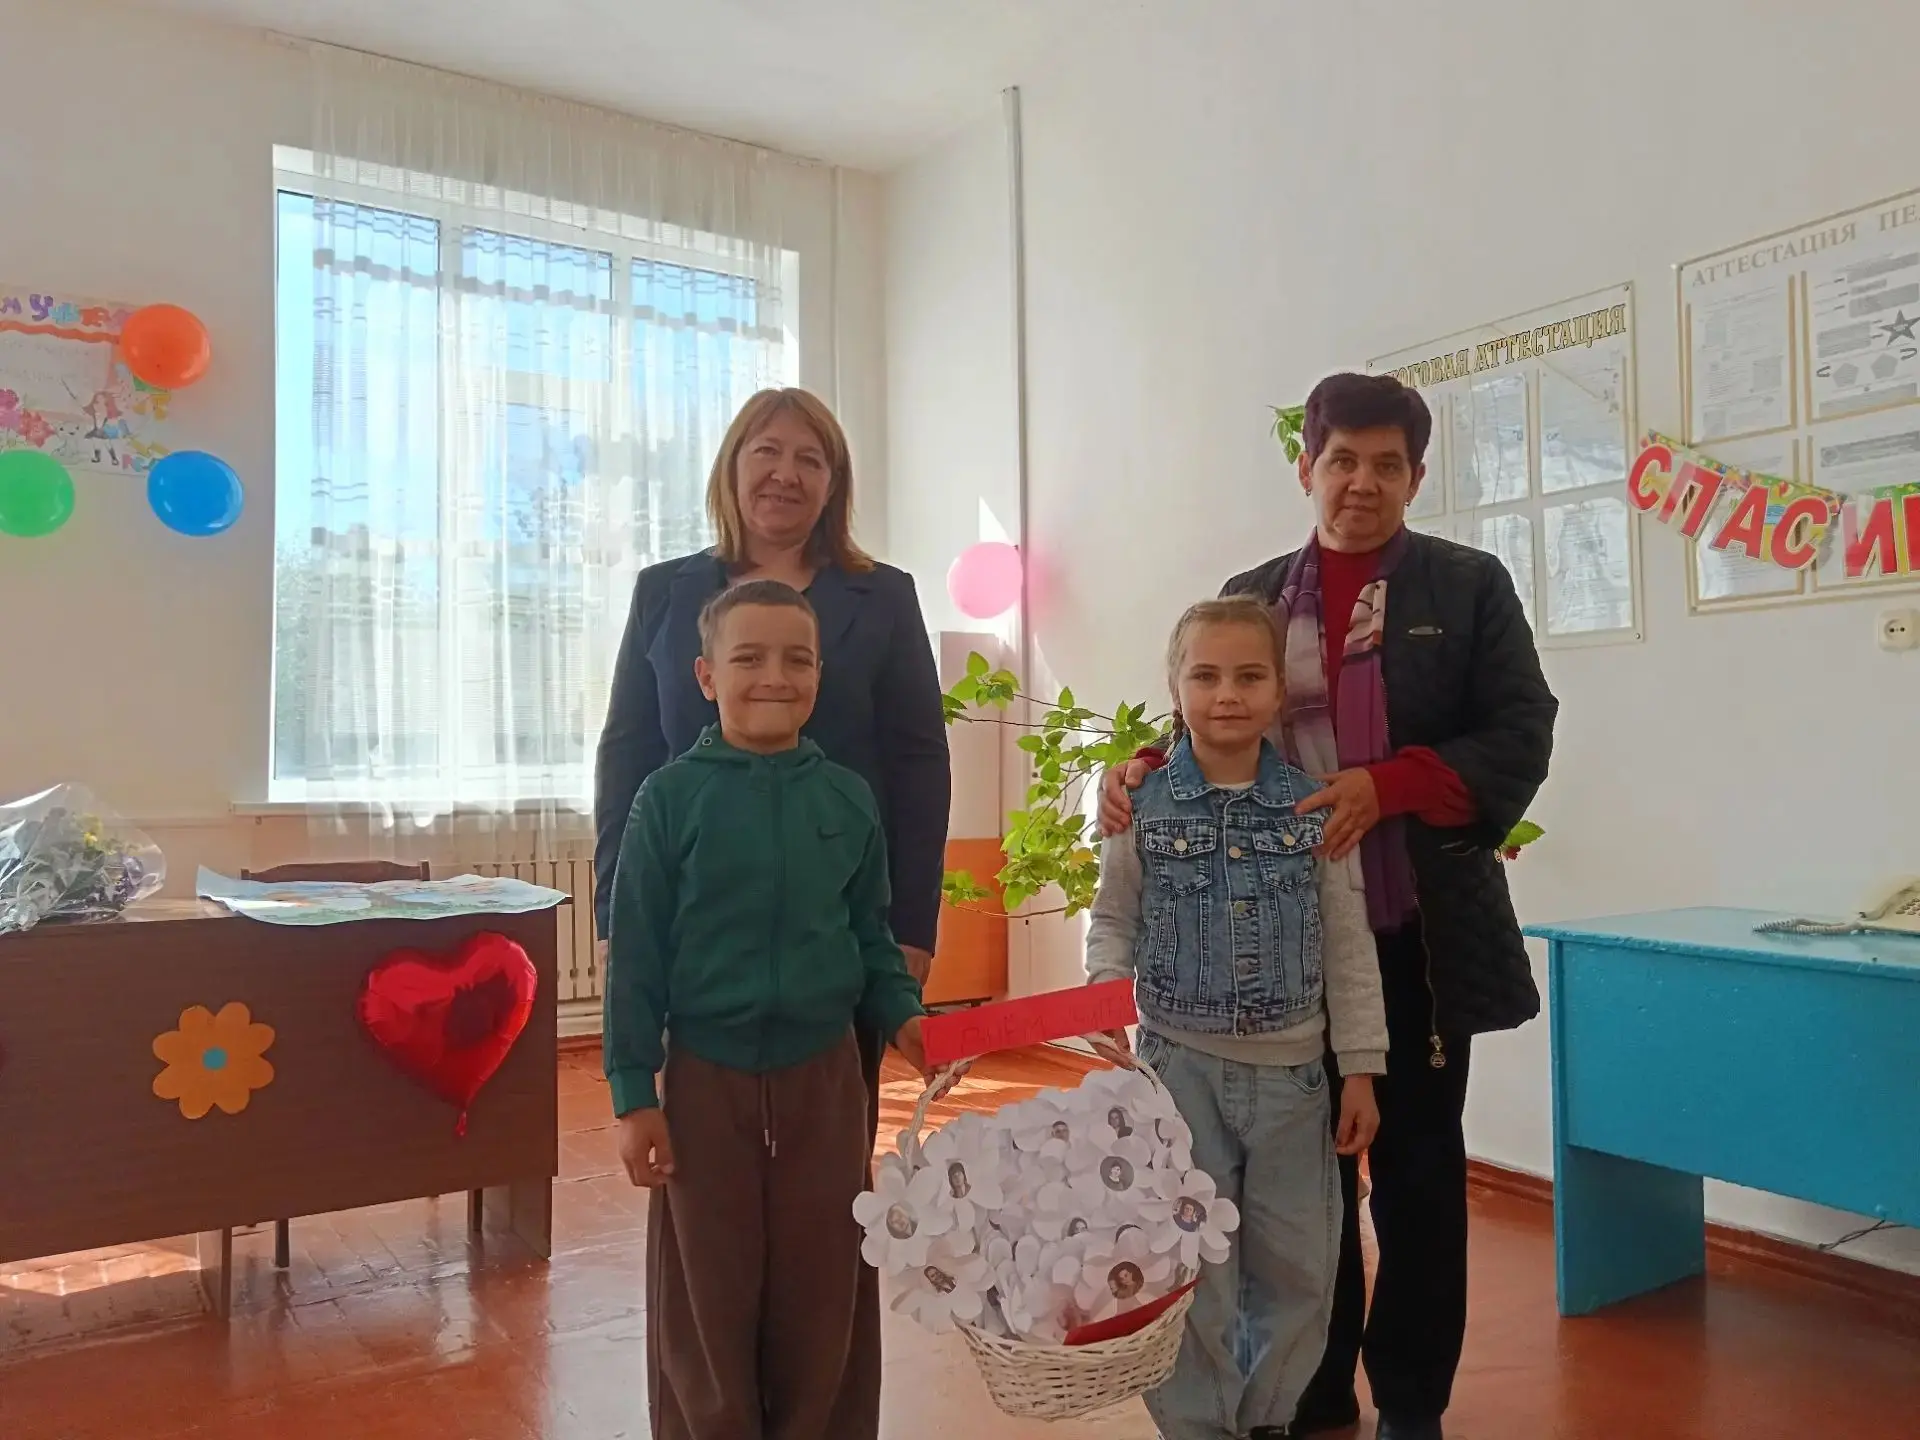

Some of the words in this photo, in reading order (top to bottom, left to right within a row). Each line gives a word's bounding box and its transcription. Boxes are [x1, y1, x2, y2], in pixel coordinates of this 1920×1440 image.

[1692, 222, 1857, 287] АТТЕСТАЦИЯ
[1878, 203, 1920, 231] ПЕ
[1383, 348, 1470, 388] ОГОВАЯ
[1474, 303, 1627, 372] АТТЕСТАЦИЯ
